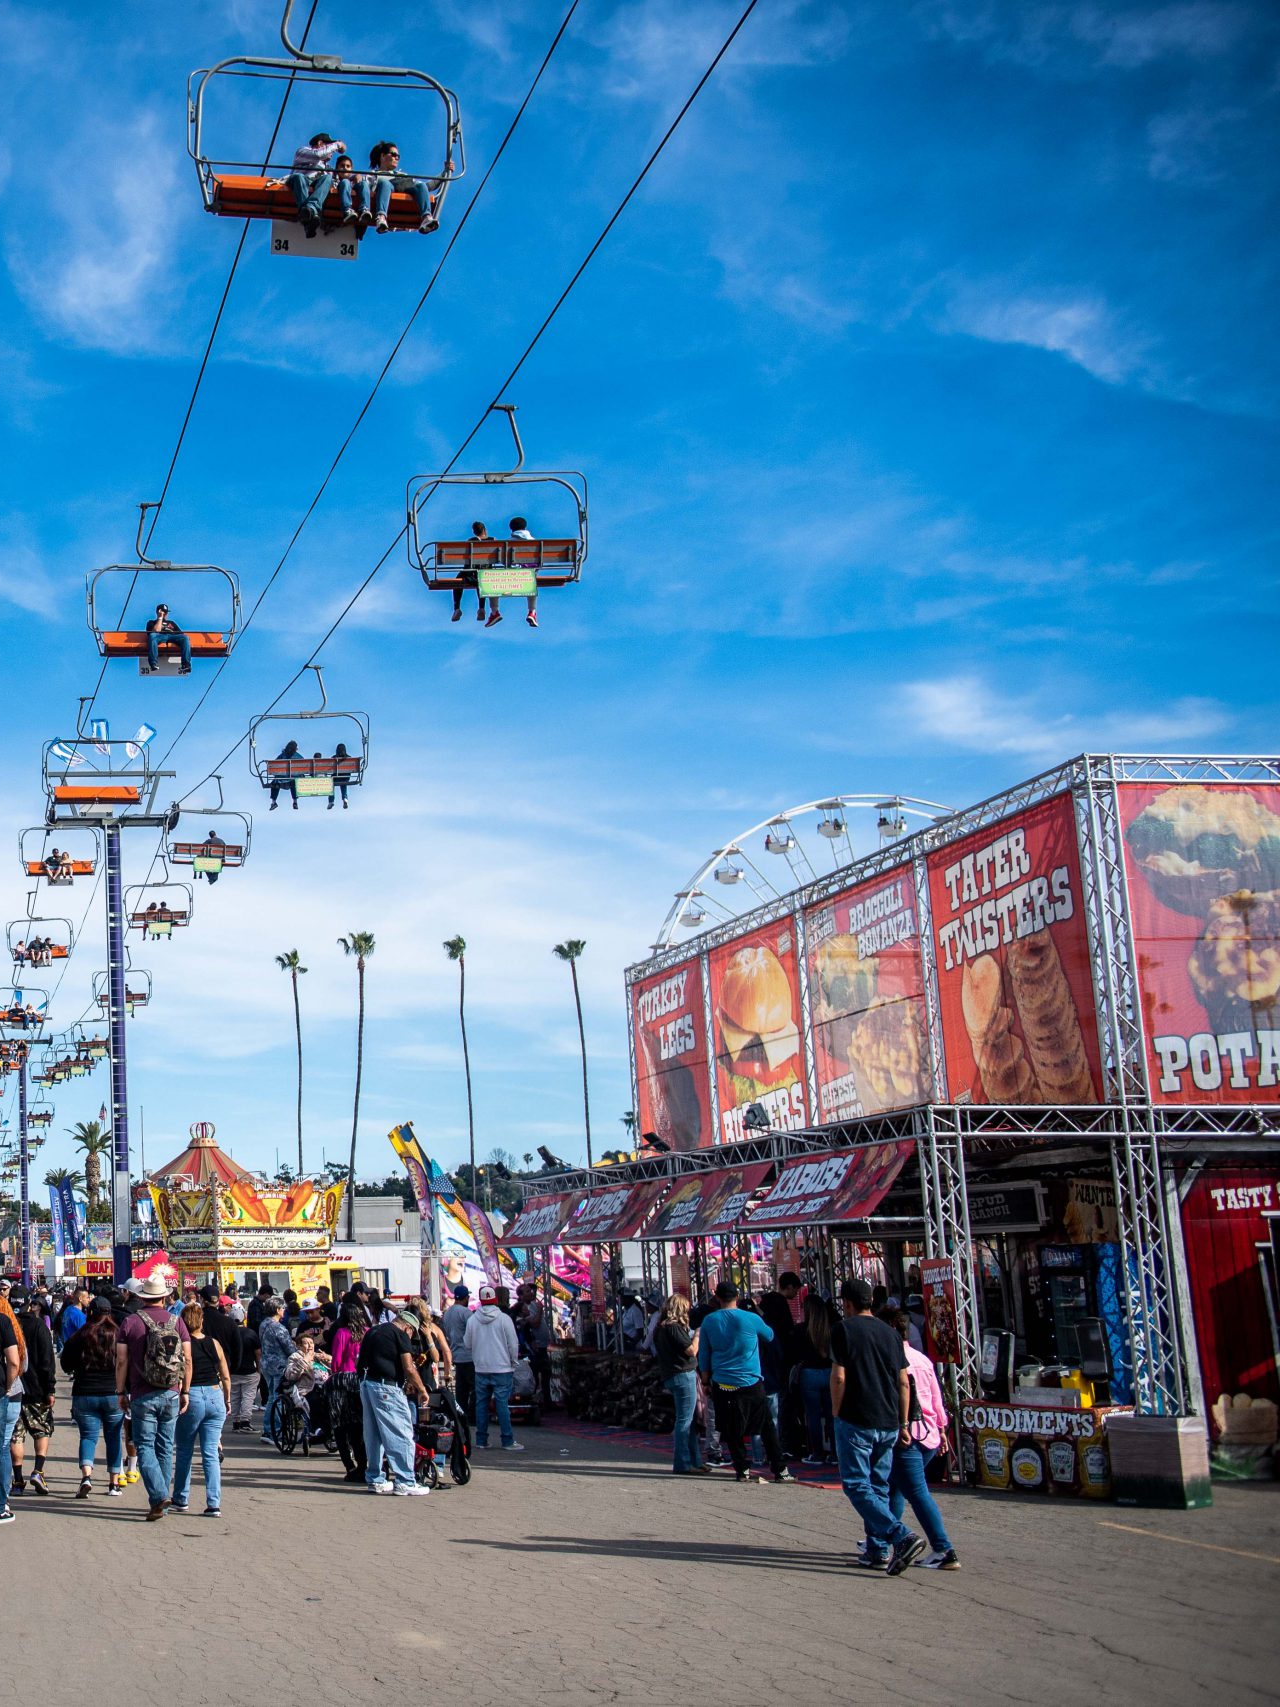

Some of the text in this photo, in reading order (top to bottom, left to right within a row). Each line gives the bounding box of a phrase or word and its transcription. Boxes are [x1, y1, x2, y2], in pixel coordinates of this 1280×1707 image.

[274, 239, 355, 256] 34 34
[944, 827, 1031, 912] TATER
[848, 880, 904, 935] BROCCOLI
[938, 865, 1075, 972] TWISTERS
[857, 908, 916, 962] BONANZA
[637, 969, 688, 1029] TURKEY
[658, 1013, 696, 1061] LEGS
[820, 1072, 857, 1110] CHEESE
[765, 1153, 856, 1202] KABOBS
[970, 1193, 1005, 1209] SPUD
[970, 1205, 1010, 1220] RANCH
[1075, 1183, 1116, 1208] WANTE
[1211, 1186, 1273, 1211] TASTY
[233, 1240, 316, 1249] CORN DOGS
[86, 1260, 114, 1274] DRAFT
[962, 1406, 1095, 1438] CONDIMENTS
